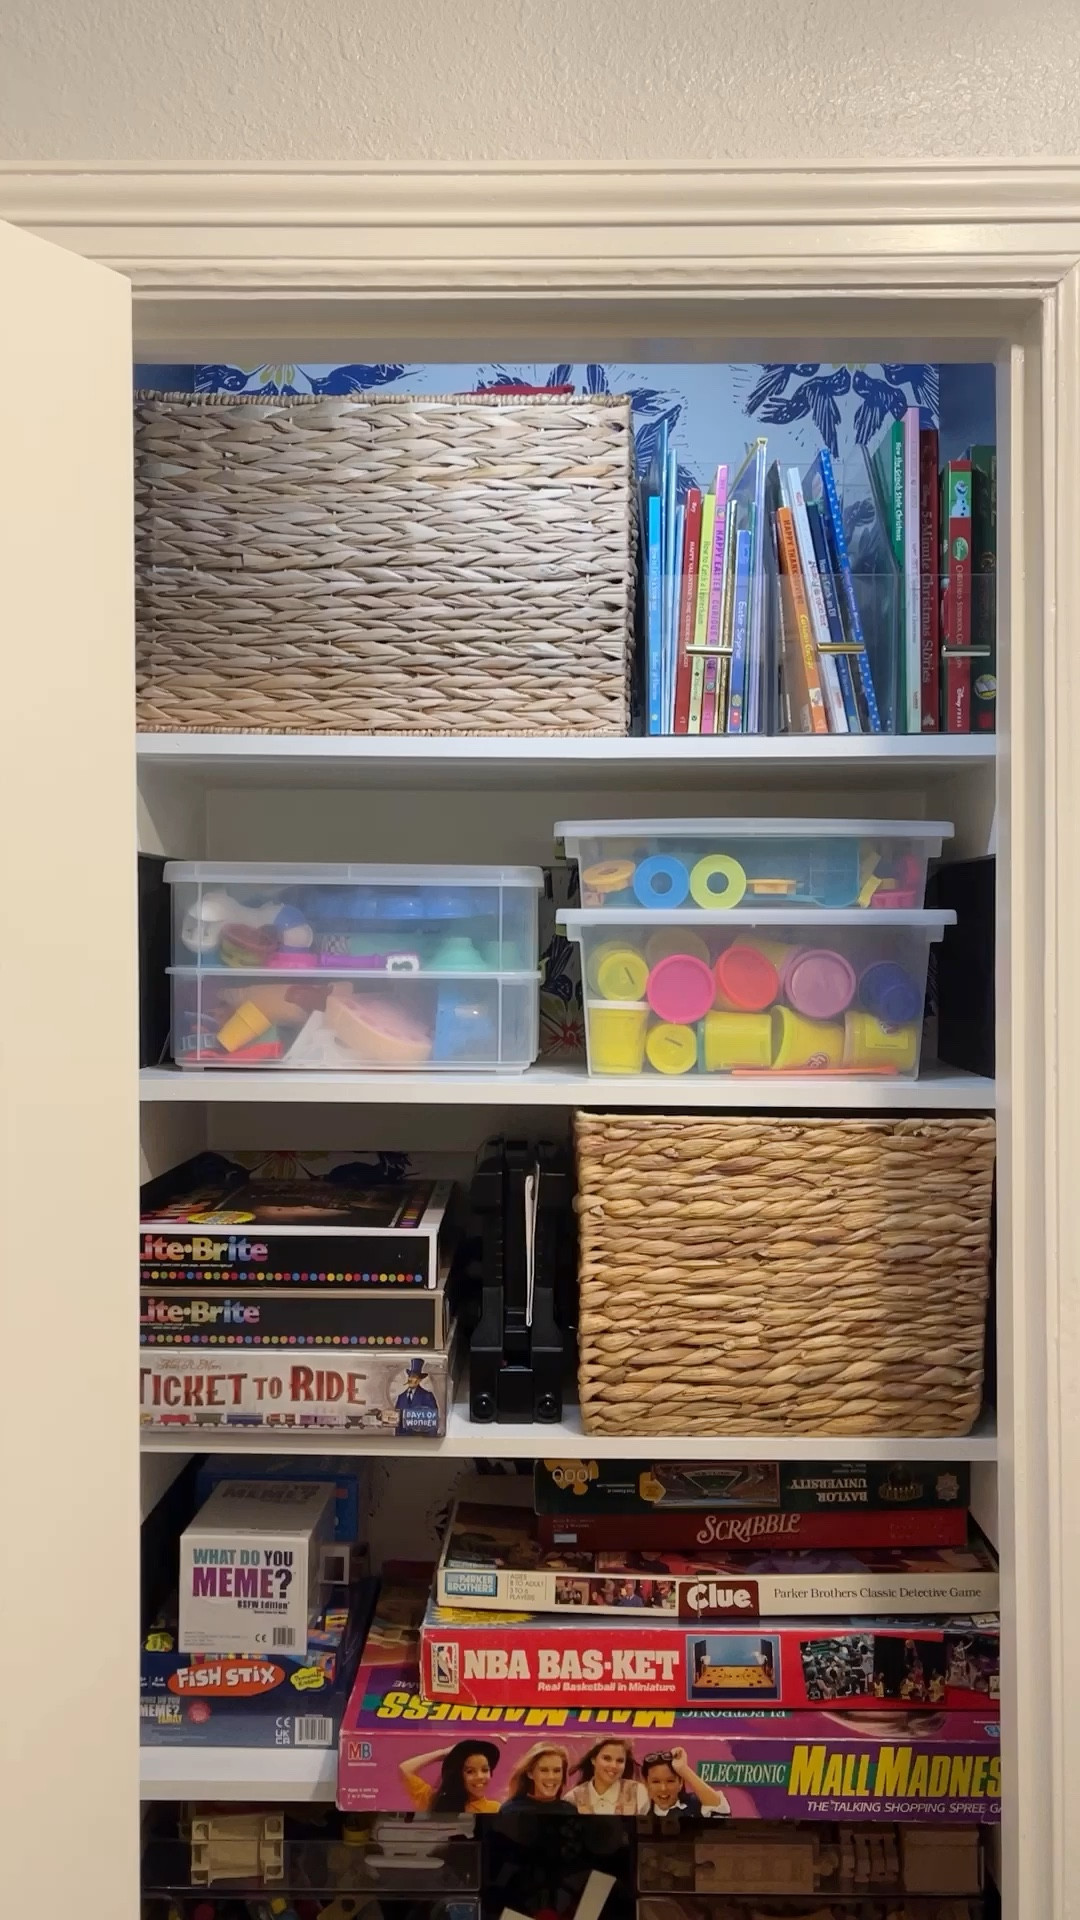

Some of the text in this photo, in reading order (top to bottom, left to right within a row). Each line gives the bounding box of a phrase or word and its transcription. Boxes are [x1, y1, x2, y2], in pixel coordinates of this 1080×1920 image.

[894, 456, 902, 469] the
[894, 470, 902, 491] Grinch
[784, 519, 794, 545] HAPPY
[716, 529, 725, 557] HAPPY
[702, 564, 710, 581] Catch
[922, 511, 934, 683] 5-Minute Christmas Stories
[710, 599, 720, 634] CURIOUS
[738, 601, 746, 626] Easter
[800, 613, 811, 642] Curious
[289, 1366, 366, 1405] RIDE
[406, 1410, 437, 1419] DAYS OF
[406, 1418, 437, 1428] WONDER
[552, 1469, 593, 1482] 1000
[790, 1478, 868, 1490] UNIVERSITY
[816, 1492, 868, 1503] BAYLOR
[696, 1512, 802, 1545] SCRABBLE
[193, 1548, 293, 1566] WHAT DO YOU
[192, 1567, 293, 1599] MEME?
[448, 1583, 494, 1593] BROTHERS
[459, 1574, 494, 1584] PARKER
[686, 1584, 752, 1611] Clue
[774, 1588, 982, 1598] Parker Brothers Classic Detective Game
[464, 1650, 530, 1680] NBA
[538, 1682, 676, 1692] Real Basketball in Miniature
[348, 1741, 372, 1760] MB
[700, 1764, 786, 1784] ELECTRONIC
[788, 1745, 870, 1796] MALL
[807, 1801, 828, 1812] THE
[832, 1802, 882, 1813] TALKING
[884, 1802, 946, 1814] SHOPPING
[948, 1802, 986, 1814] SPREE
